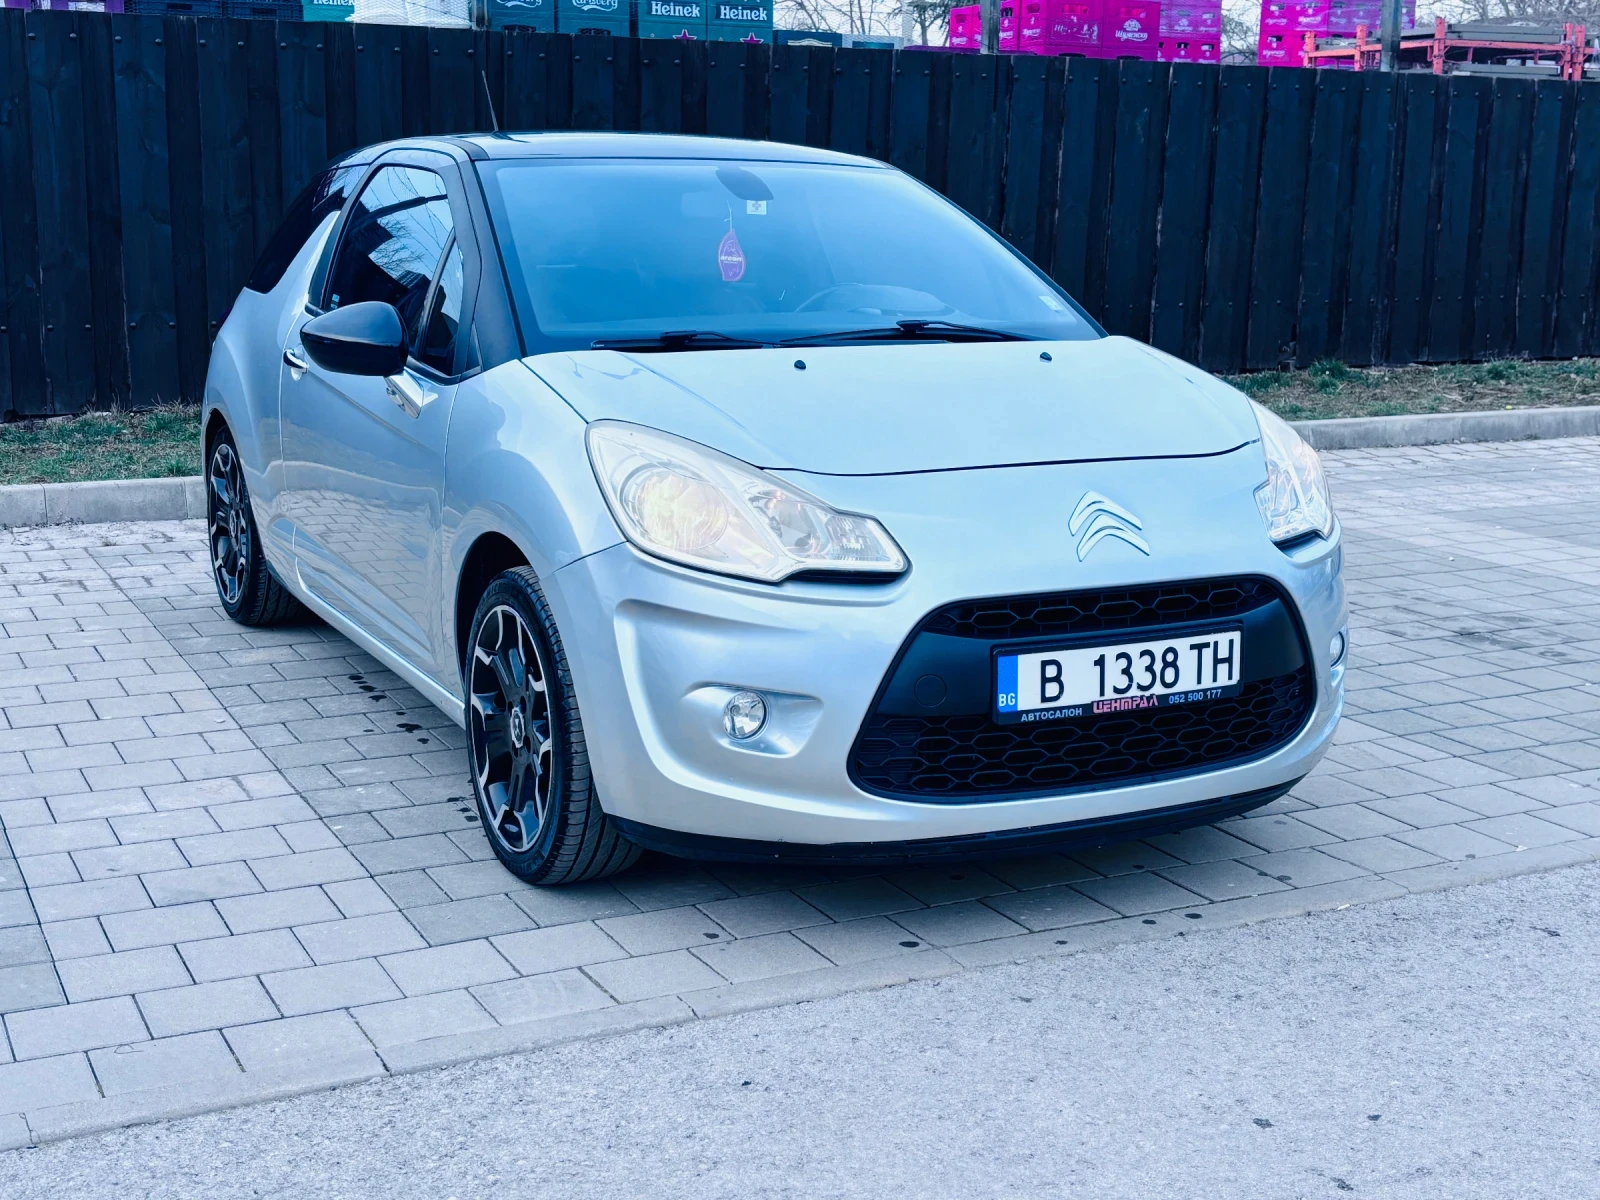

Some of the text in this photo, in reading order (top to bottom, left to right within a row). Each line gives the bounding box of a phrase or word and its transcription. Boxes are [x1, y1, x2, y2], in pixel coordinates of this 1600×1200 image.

[651, 1, 700, 17] Heinek
[720, 5, 767, 21] Heinek
[1040, 638, 1234, 704] B 1338 TH
[998, 692, 1016, 707] BG
[1020, 707, 1083, 722] АВТОСАЛОН
[1168, 694, 1186, 704] 052
[1187, 691, 1204, 702] 500
[1206, 688, 1222, 699] 177
